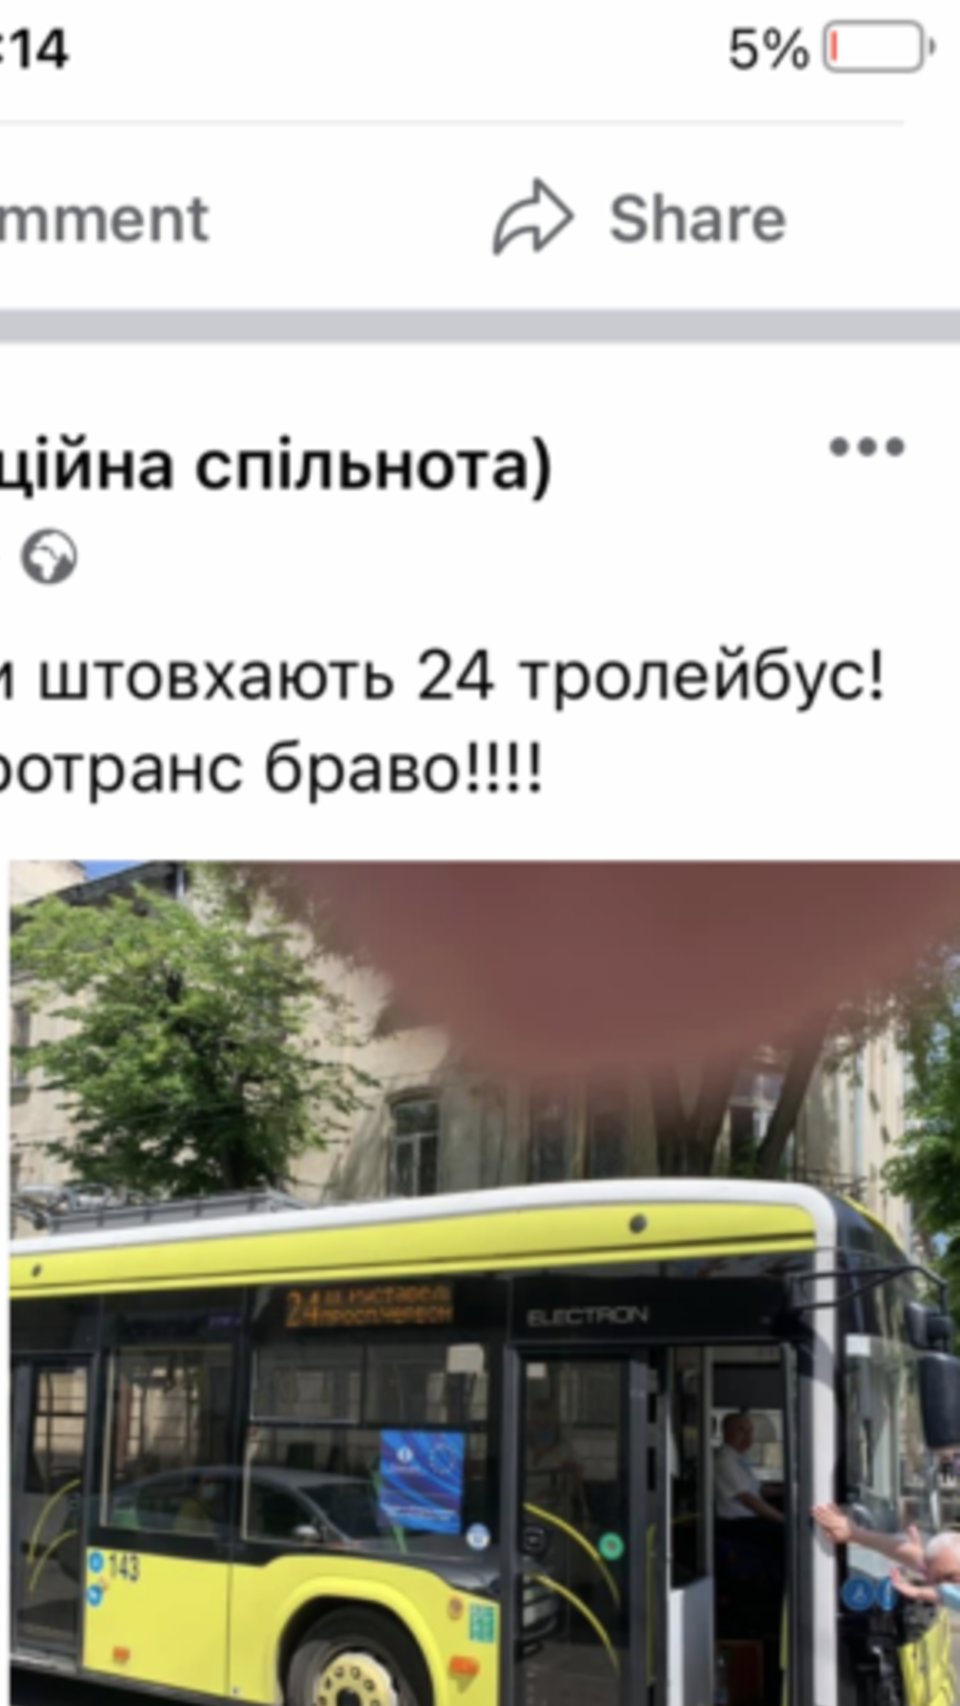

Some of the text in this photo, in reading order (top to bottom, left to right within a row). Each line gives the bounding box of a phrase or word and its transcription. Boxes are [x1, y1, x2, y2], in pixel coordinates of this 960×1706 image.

[730, 27, 810, 71] 5%
[610, 193, 786, 243] Share
[195, 434, 552, 501] спільнота)
[39, 660, 395, 702] штовхають
[418, 647, 496, 701] 24
[517, 645, 883, 713] тролейбус!
[265, 739, 542, 805] браво!!!!
[285, 1289, 321, 1327] 24
[527, 1305, 649, 1328] ELECTRON
[109, 1551, 141, 1584] 143
